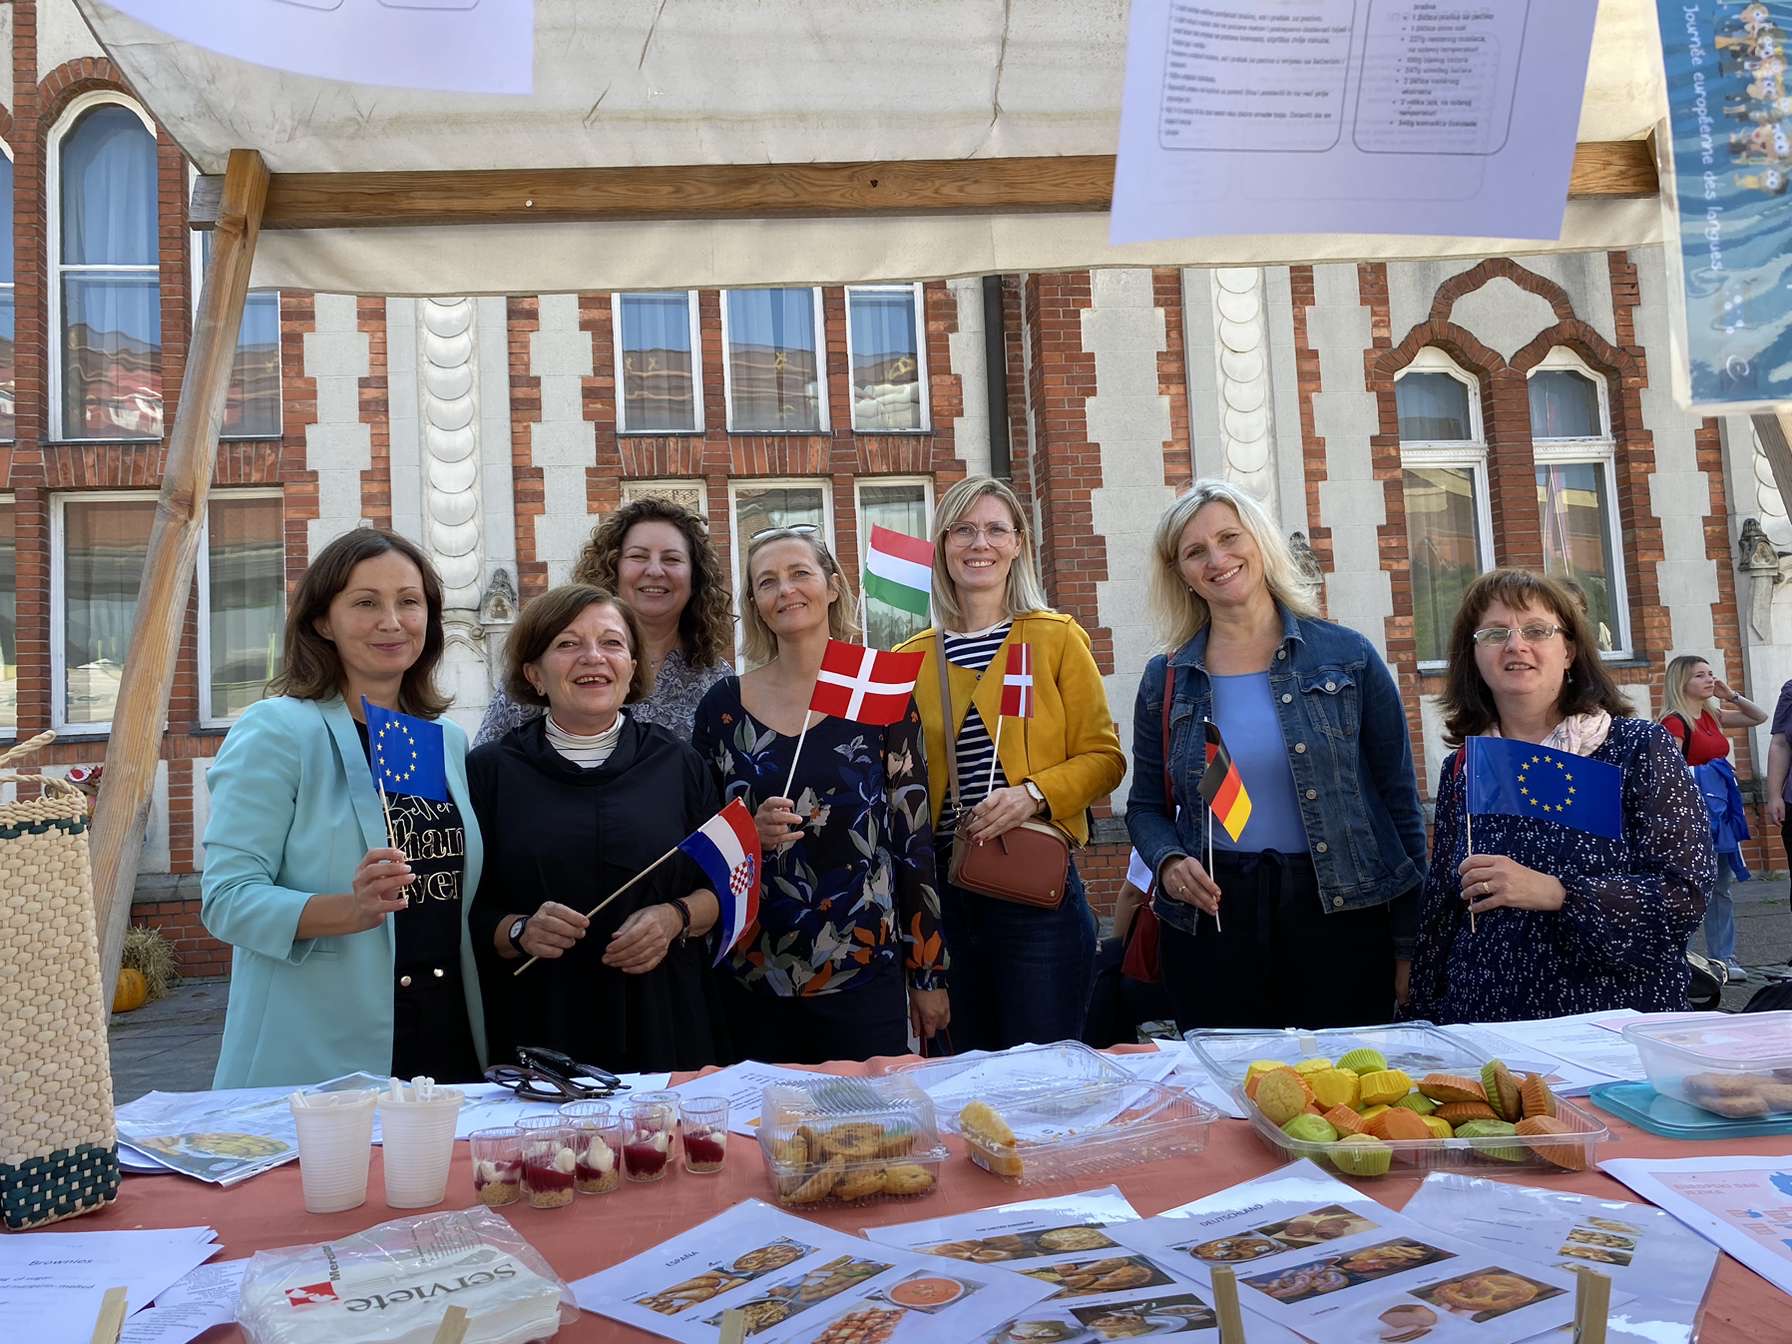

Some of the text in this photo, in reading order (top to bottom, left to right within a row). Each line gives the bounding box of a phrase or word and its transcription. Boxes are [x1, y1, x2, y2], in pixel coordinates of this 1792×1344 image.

[1683, 4, 1723, 270] Journée européenne des langues
[388, 818, 464, 861] han
[1199, 1203, 1264, 1228] DEUTSCHLAND
[344, 1263, 517, 1312] serviete
